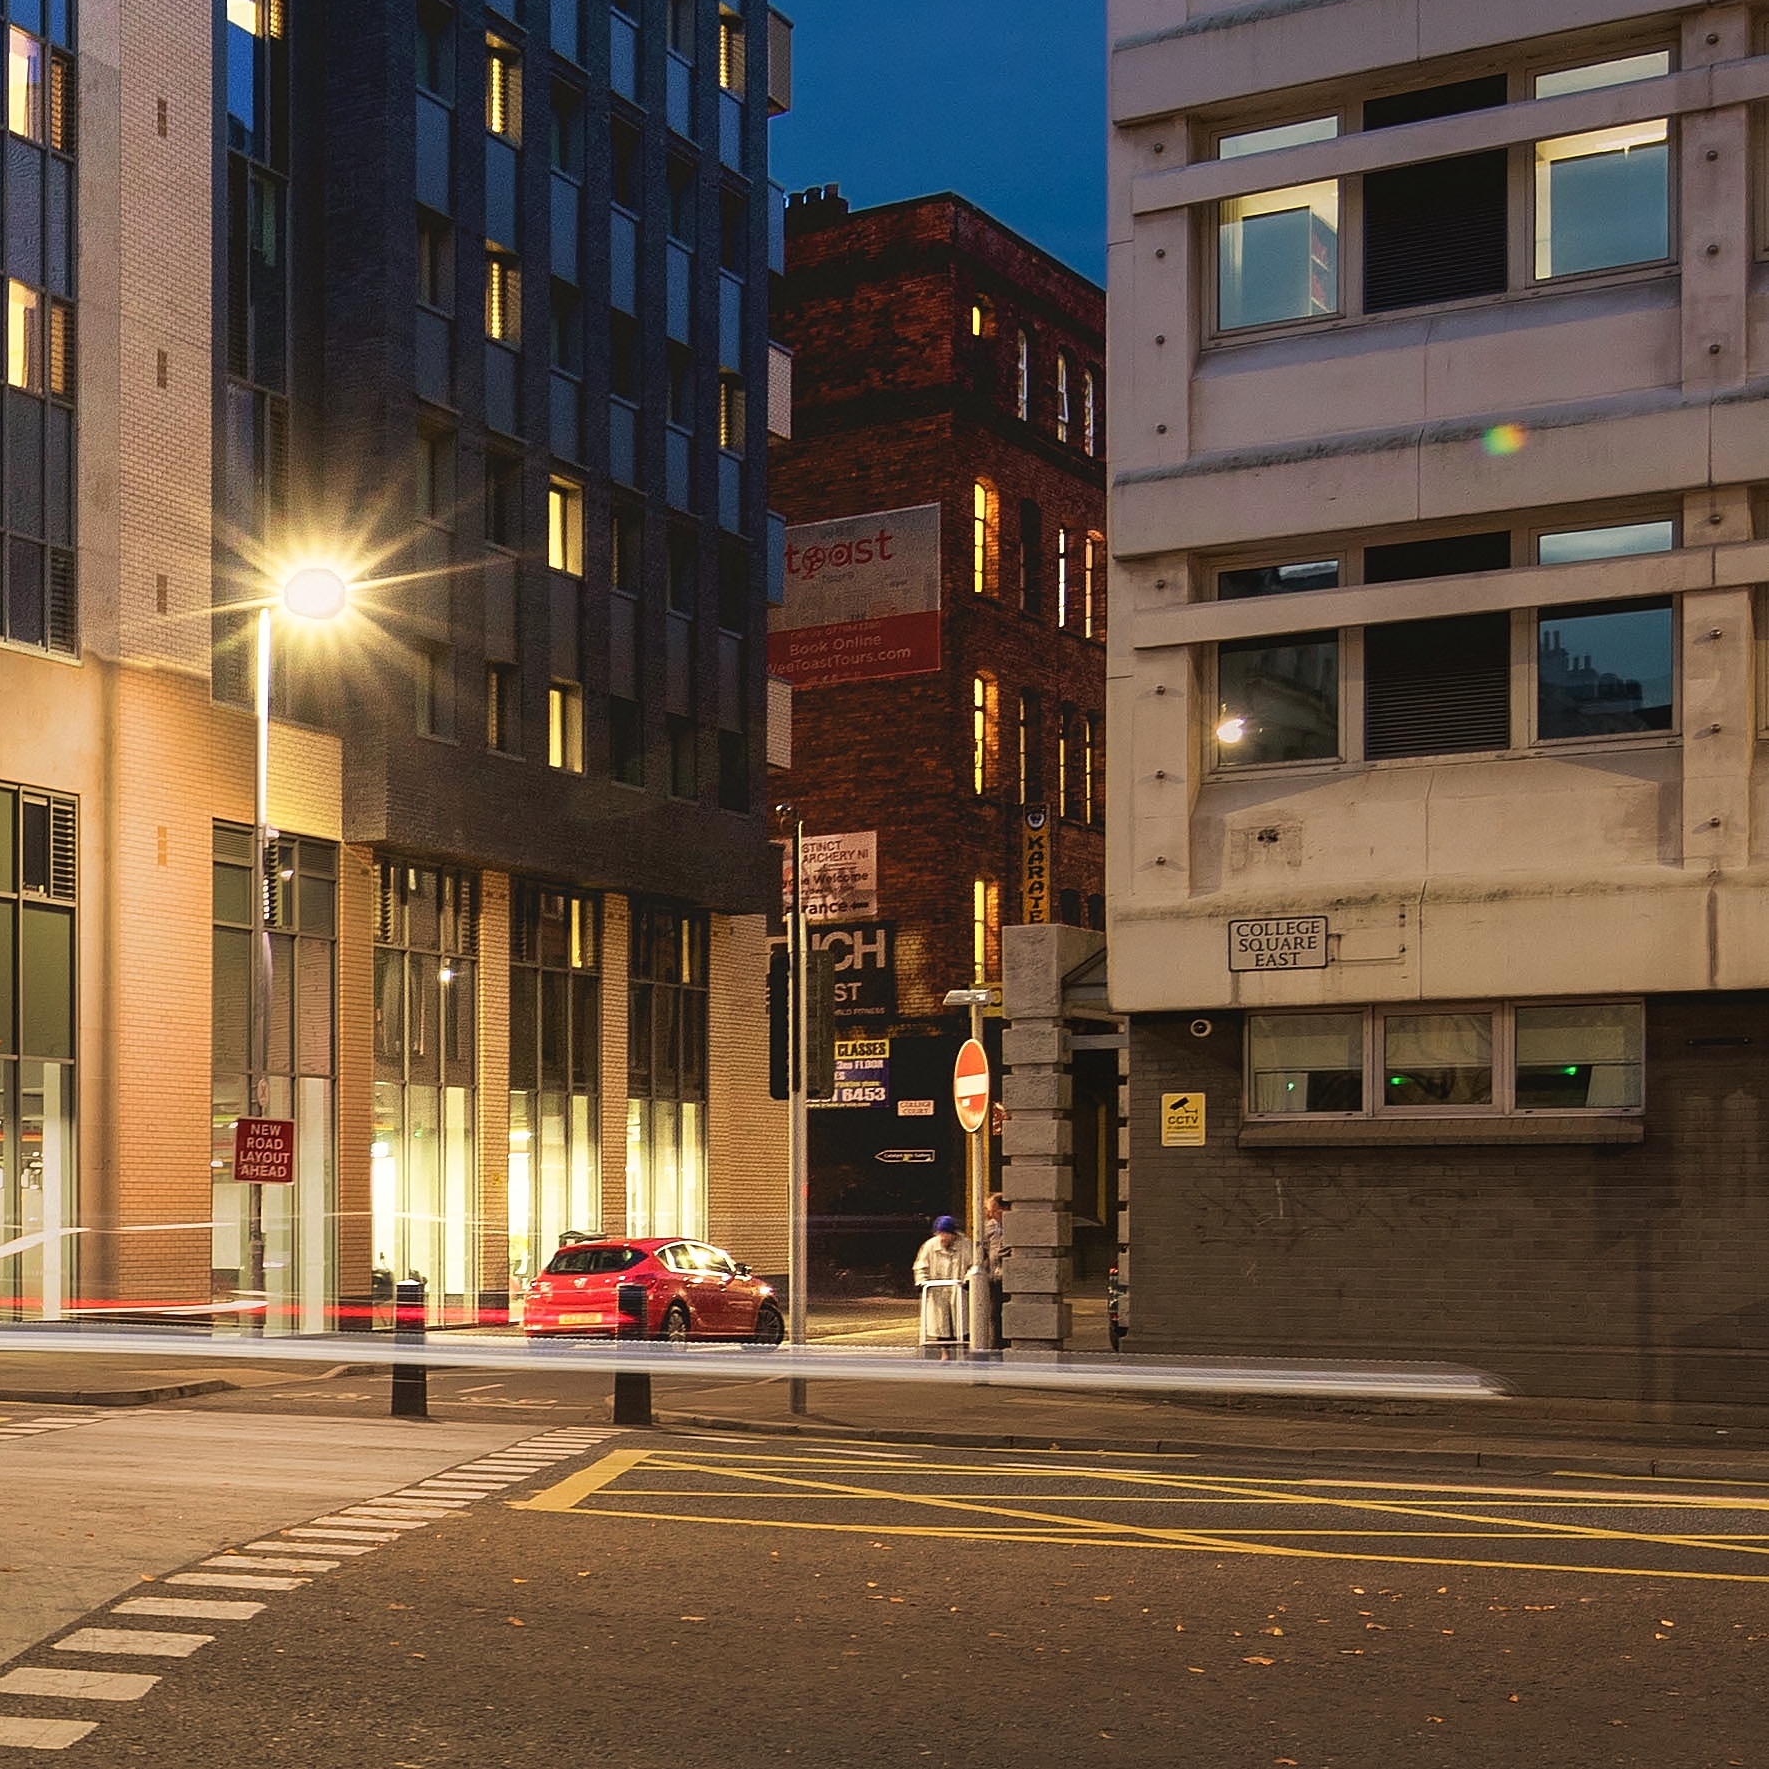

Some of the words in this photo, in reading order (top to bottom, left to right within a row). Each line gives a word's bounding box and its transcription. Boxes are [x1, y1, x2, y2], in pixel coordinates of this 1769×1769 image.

[784, 529, 895, 580] toast
[790, 640, 830, 657] Book
[833, 635, 882, 650] Online
[802, 850, 856, 864] ARCHERY
[813, 872, 869, 885] Welcome
[1026, 835, 1045, 924] KARATE
[1236, 920, 1320, 937] COLLEGE
[1238, 936, 1318, 953] SQUARE
[1254, 952, 1301, 967] EAST
[837, 1042, 886, 1057] CLASSES
[842, 1087, 886, 1102] 6453
[1167, 1115, 1199, 1124] CCTV
[250, 1124, 281, 1136] NEW
[246, 1137, 284, 1150] ROAD
[240, 1151, 291, 1164] LAYOUT
[241, 1165, 287, 1177] AHEAD
